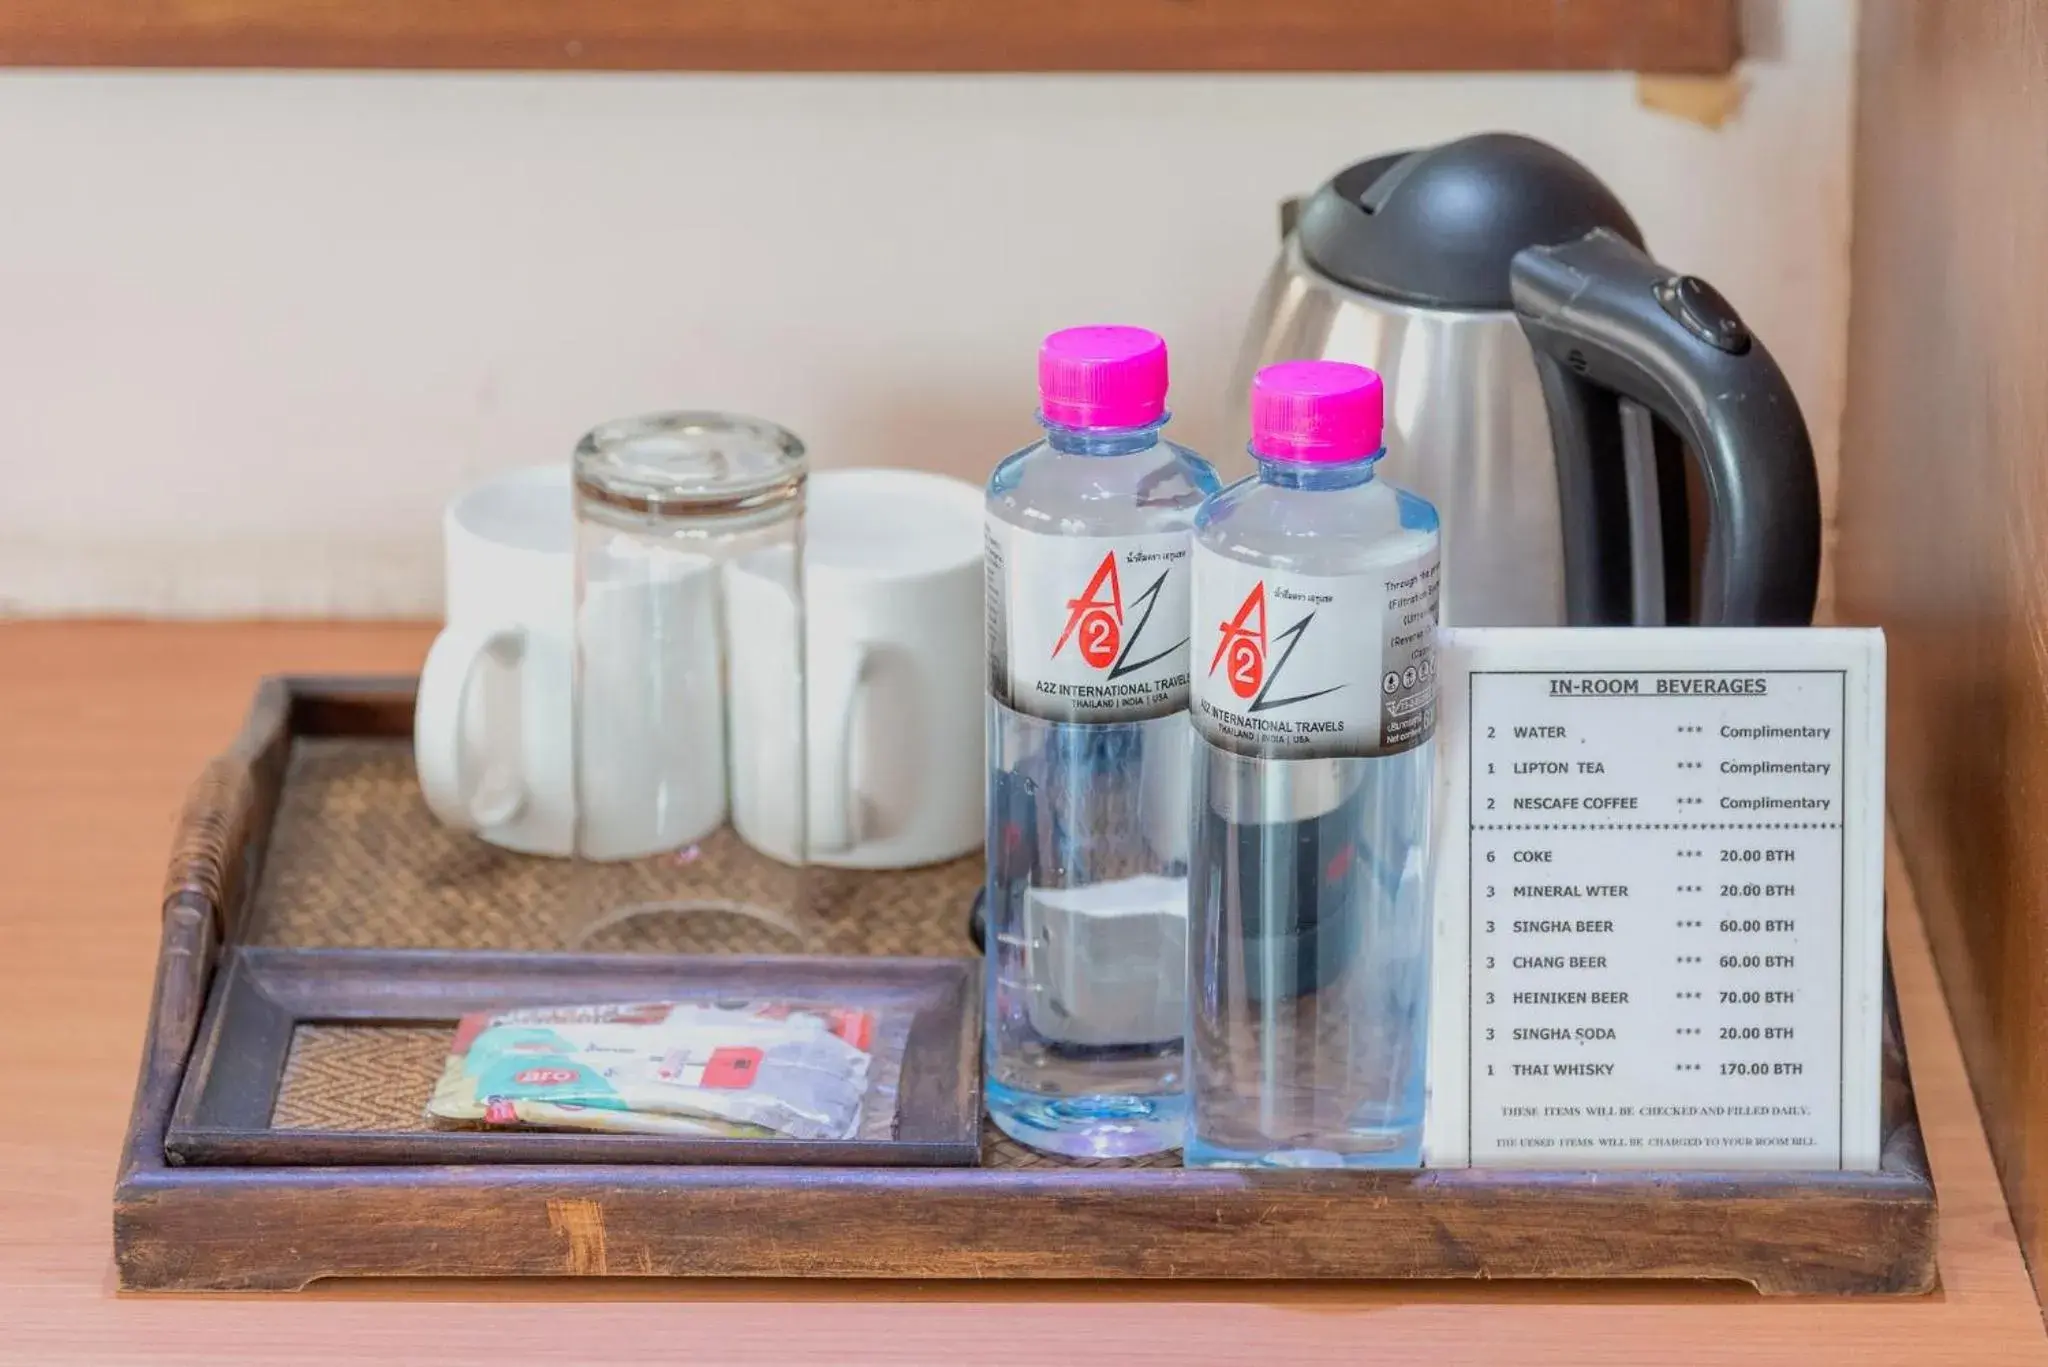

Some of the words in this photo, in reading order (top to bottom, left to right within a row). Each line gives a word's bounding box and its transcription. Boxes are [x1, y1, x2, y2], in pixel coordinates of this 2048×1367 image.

[1036, 680, 1056, 694] A2Z
[1059, 681, 1152, 697] INTERNATIONAL
[1550, 679, 1641, 696] IN-ROOM
[1654, 679, 1767, 696] BEVERAGES
[1072, 698, 1114, 708] THAILAND
[1122, 697, 1144, 706] INDIA
[1152, 693, 1169, 703] USA
[1212, 706, 1293, 733] INTERNATIONAL
[1295, 720, 1344, 732] TRAVELS
[1218, 723, 1254, 740] THAILAND
[1293, 735, 1310, 743] USA
[1487, 726, 1495, 738] 2
[1514, 726, 1566, 738] WATER
[1720, 725, 1830, 740] Complimentary
[1488, 763, 1495, 774] 1
[1514, 762, 1568, 774] LIPTON
[1577, 762, 1605, 774] TEA
[1720, 761, 1831, 776] Complimentary
[1487, 798, 1495, 809] 2
[1514, 798, 1579, 809] NESCAFE
[1583, 797, 1638, 809] COFFEE
[1720, 797, 1830, 811] Complimentary
[1487, 851, 1495, 863] 6
[1514, 851, 1552, 862] COKE
[1721, 850, 1761, 862] 20.00
[1766, 850, 1794, 861] BTH
[1486, 886, 1495, 898] 3
[1514, 886, 1582, 897] MINERAL
[1587, 886, 1628, 896] WTER
[1720, 883, 1761, 896] 20.00
[1766, 885, 1794, 896] BTH
[1486, 921, 1495, 933] 3
[1513, 920, 1572, 933] SINGHA
[1576, 921, 1613, 932] BEER
[1720, 920, 1760, 932] 60.00
[1766, 920, 1794, 932] BTH
[1487, 957, 1495, 969] 3
[1513, 956, 1564, 968] CHANG
[1570, 956, 1607, 968] BEER
[1720, 955, 1760, 968] 60.00
[1765, 956, 1794, 968] BTH
[1486, 992, 1495, 1004] 3
[1513, 992, 1586, 1004] HEINIKEN
[1591, 992, 1628, 1004] BEER
[1720, 991, 1760, 1004] 70.00
[1765, 991, 1794, 1003] BTH
[1486, 1028, 1495, 1040] 3
[1513, 1028, 1571, 1040] SINGHA
[1575, 1028, 1616, 1040] SODA
[1720, 1027, 1760, 1040] 20.00
[1765, 1028, 1793, 1039] BTH
[521, 1070, 572, 1082] aro
[1488, 1065, 1494, 1076] 1
[1512, 1064, 1548, 1076] THAI
[1553, 1064, 1614, 1076] WHISKY
[1721, 1063, 1769, 1075] 170.00
[1774, 1063, 1802, 1075] BTH
[1502, 1105, 1538, 1117] THESE
[1544, 1105, 1580, 1117] ITEMS
[1586, 1105, 1617, 1117] WILL
[1619, 1105, 1635, 1117] BE
[1640, 1105, 1697, 1117] CHECKED
[1700, 1105, 1724, 1117] AND
[1727, 1105, 1769, 1117] FILLED
[1772, 1105, 1811, 1117] DAILY.
[1496, 1137, 1518, 1148] THE
[1559, 1137, 1594, 1148] ITEMS
[1599, 1137, 1629, 1148] WILL
[1630, 1137, 1644, 1148] BE
[1649, 1137, 1701, 1148] CHARGED
[1705, 1137, 1719, 1148] TO
[1723, 1137, 1753, 1148] YOUR
[1756, 1137, 1790, 1148] ROOM
[1792, 1137, 1816, 1148] BILL.
